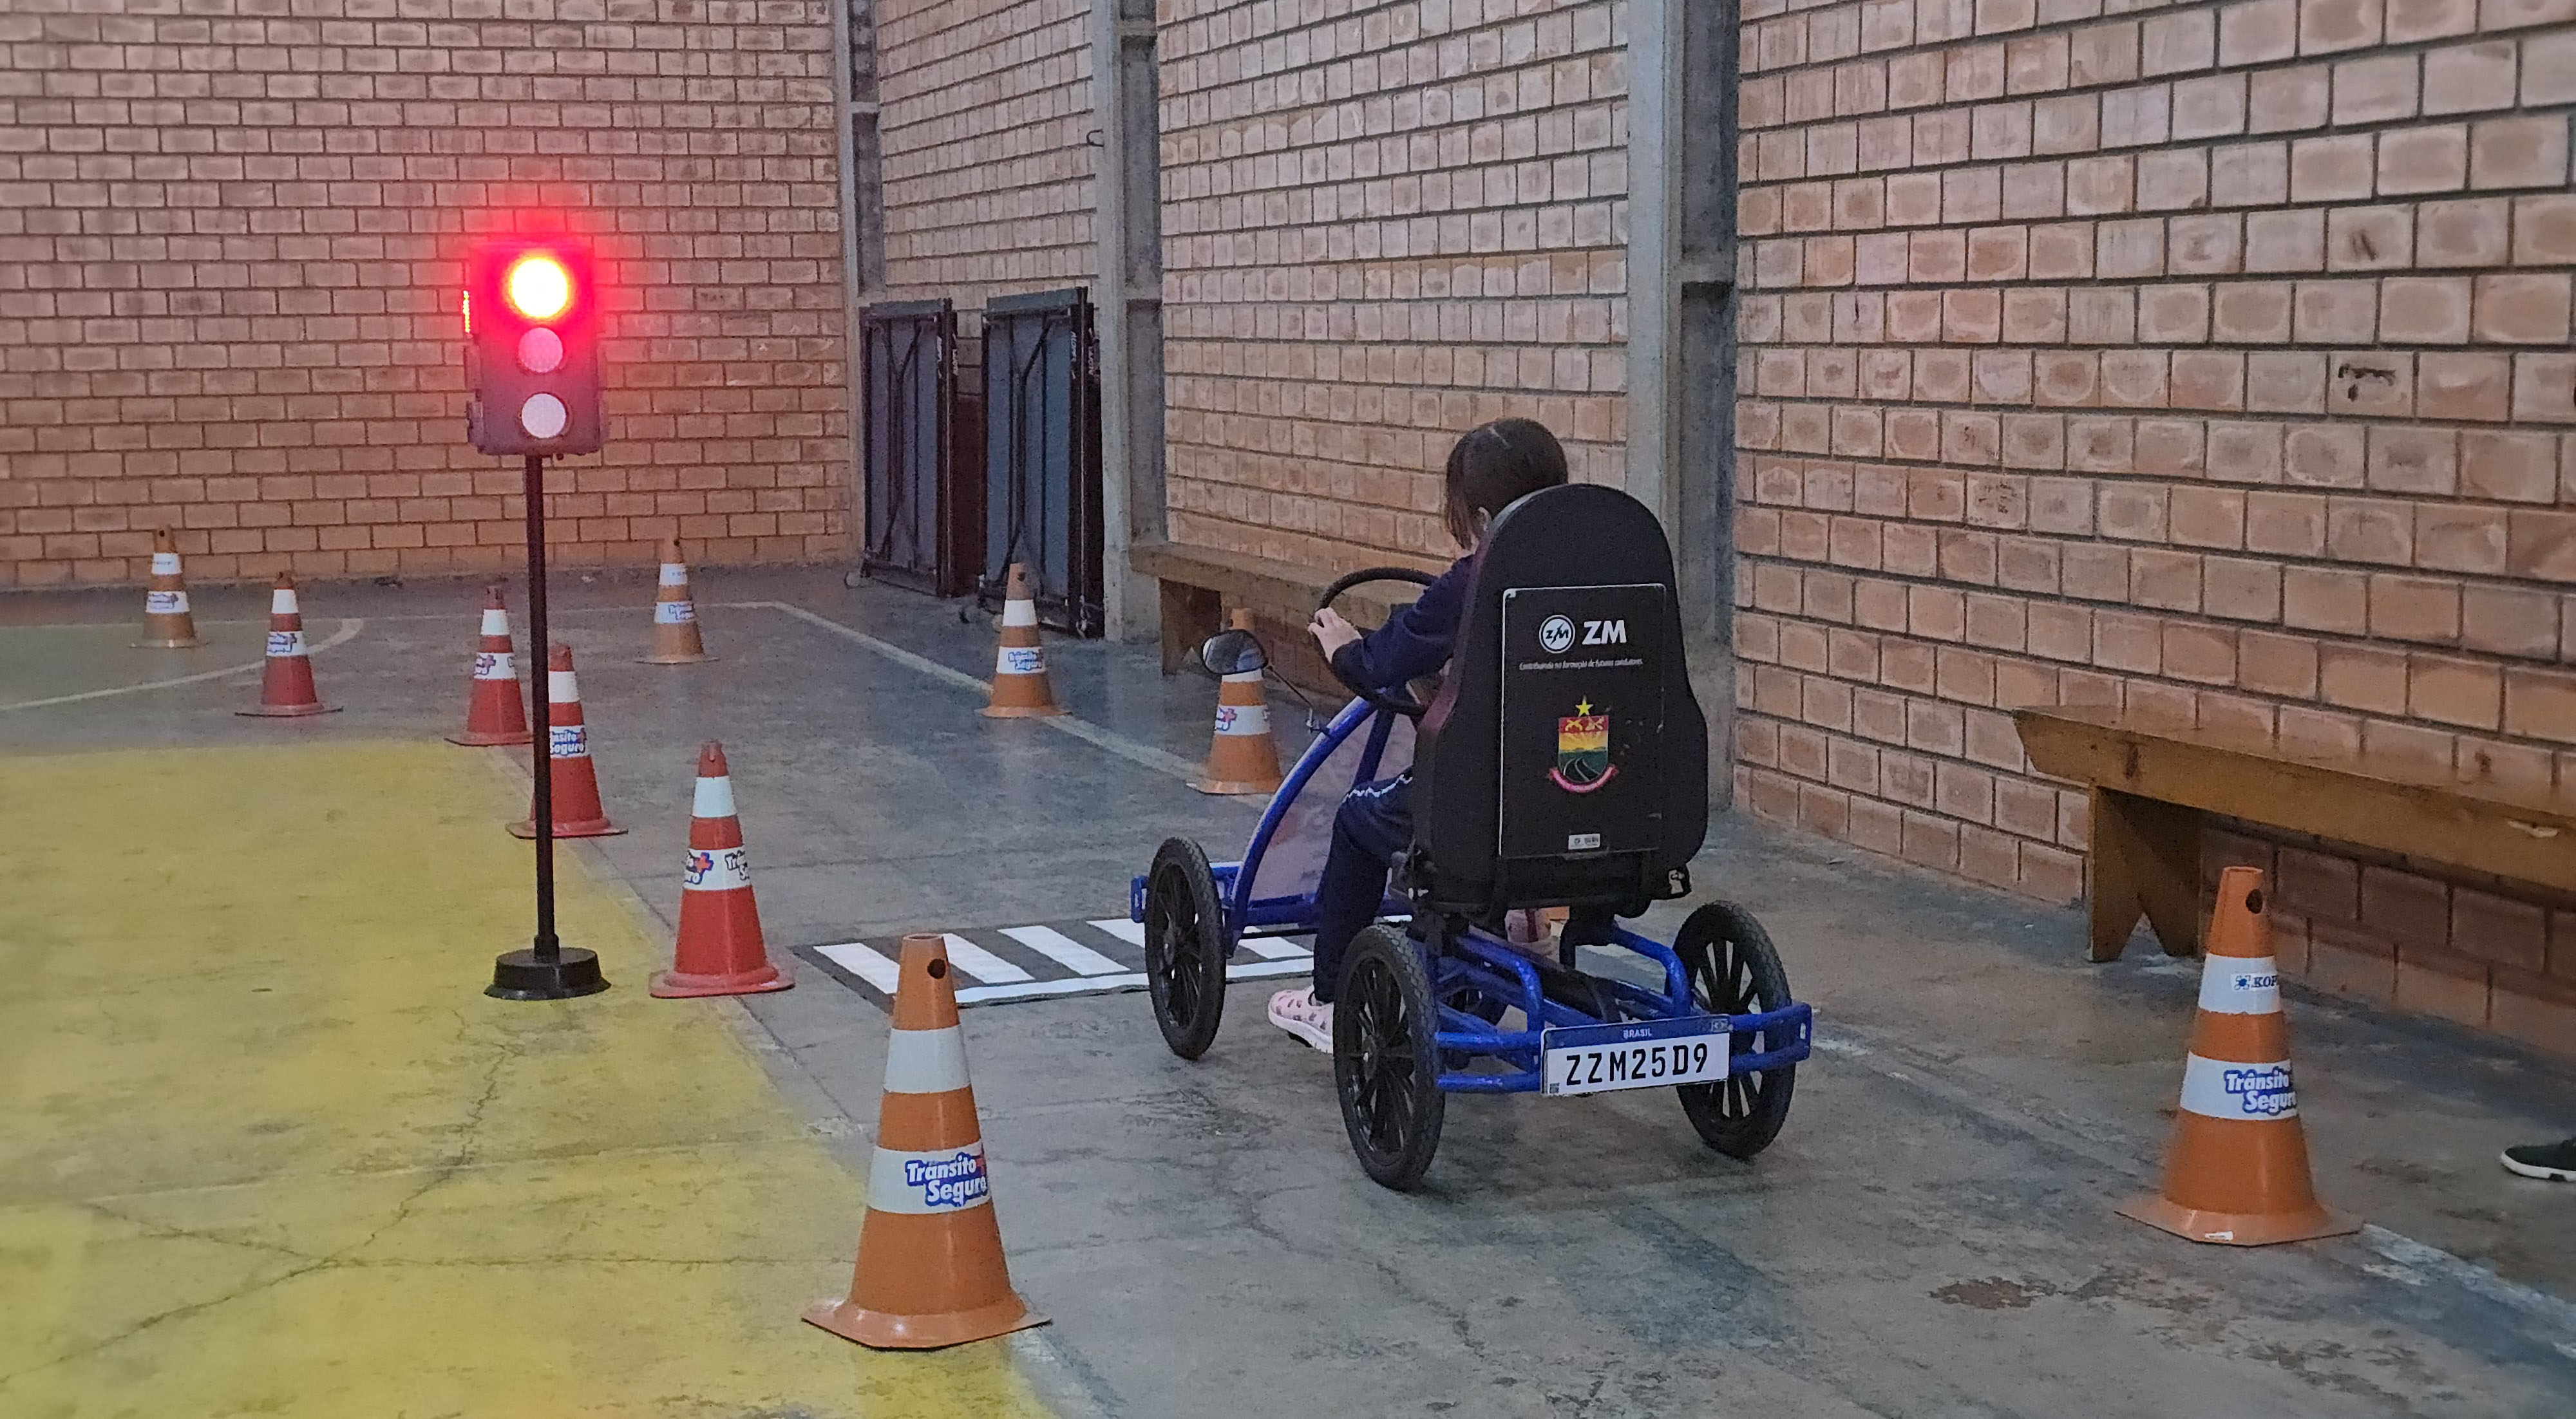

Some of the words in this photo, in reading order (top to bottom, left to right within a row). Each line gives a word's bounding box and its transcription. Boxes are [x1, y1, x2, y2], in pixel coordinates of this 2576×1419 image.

[1582, 619, 1627, 644] ZM
[1623, 1028, 1652, 1039] BRASIL
[1566, 1042, 1708, 1086] ZZM25D9
[2225, 1069, 2290, 1091] Trânsito
[927, 1176, 987, 1205] Seguro
